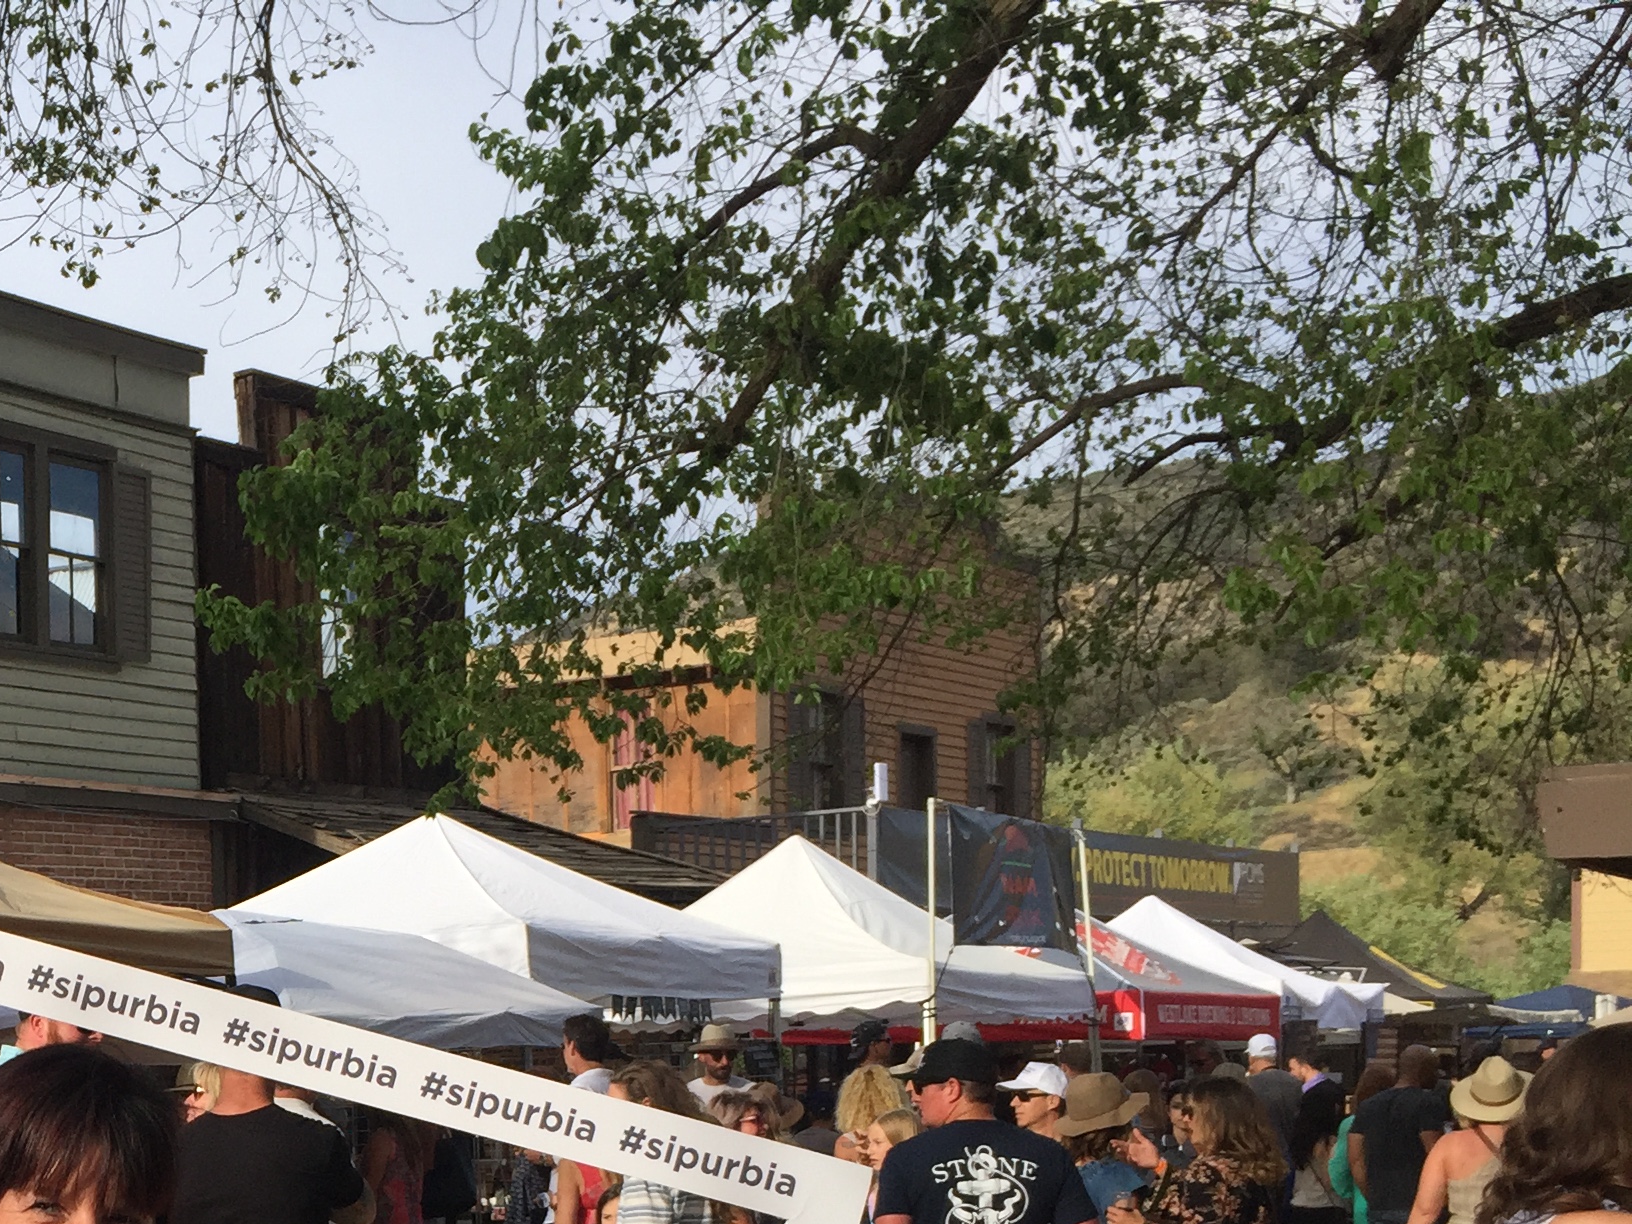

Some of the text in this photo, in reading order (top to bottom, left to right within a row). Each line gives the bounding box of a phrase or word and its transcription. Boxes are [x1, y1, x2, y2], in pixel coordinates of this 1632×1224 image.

[1085, 849, 1146, 887] PROTECT
[28, 965, 199, 1034] #sipurbia
[223, 1019, 396, 1088] #sipurbia
[421, 1073, 595, 1142] #sipurbia
[620, 1126, 795, 1196] #sipurbia
[931, 1152, 1040, 1184] STONE
